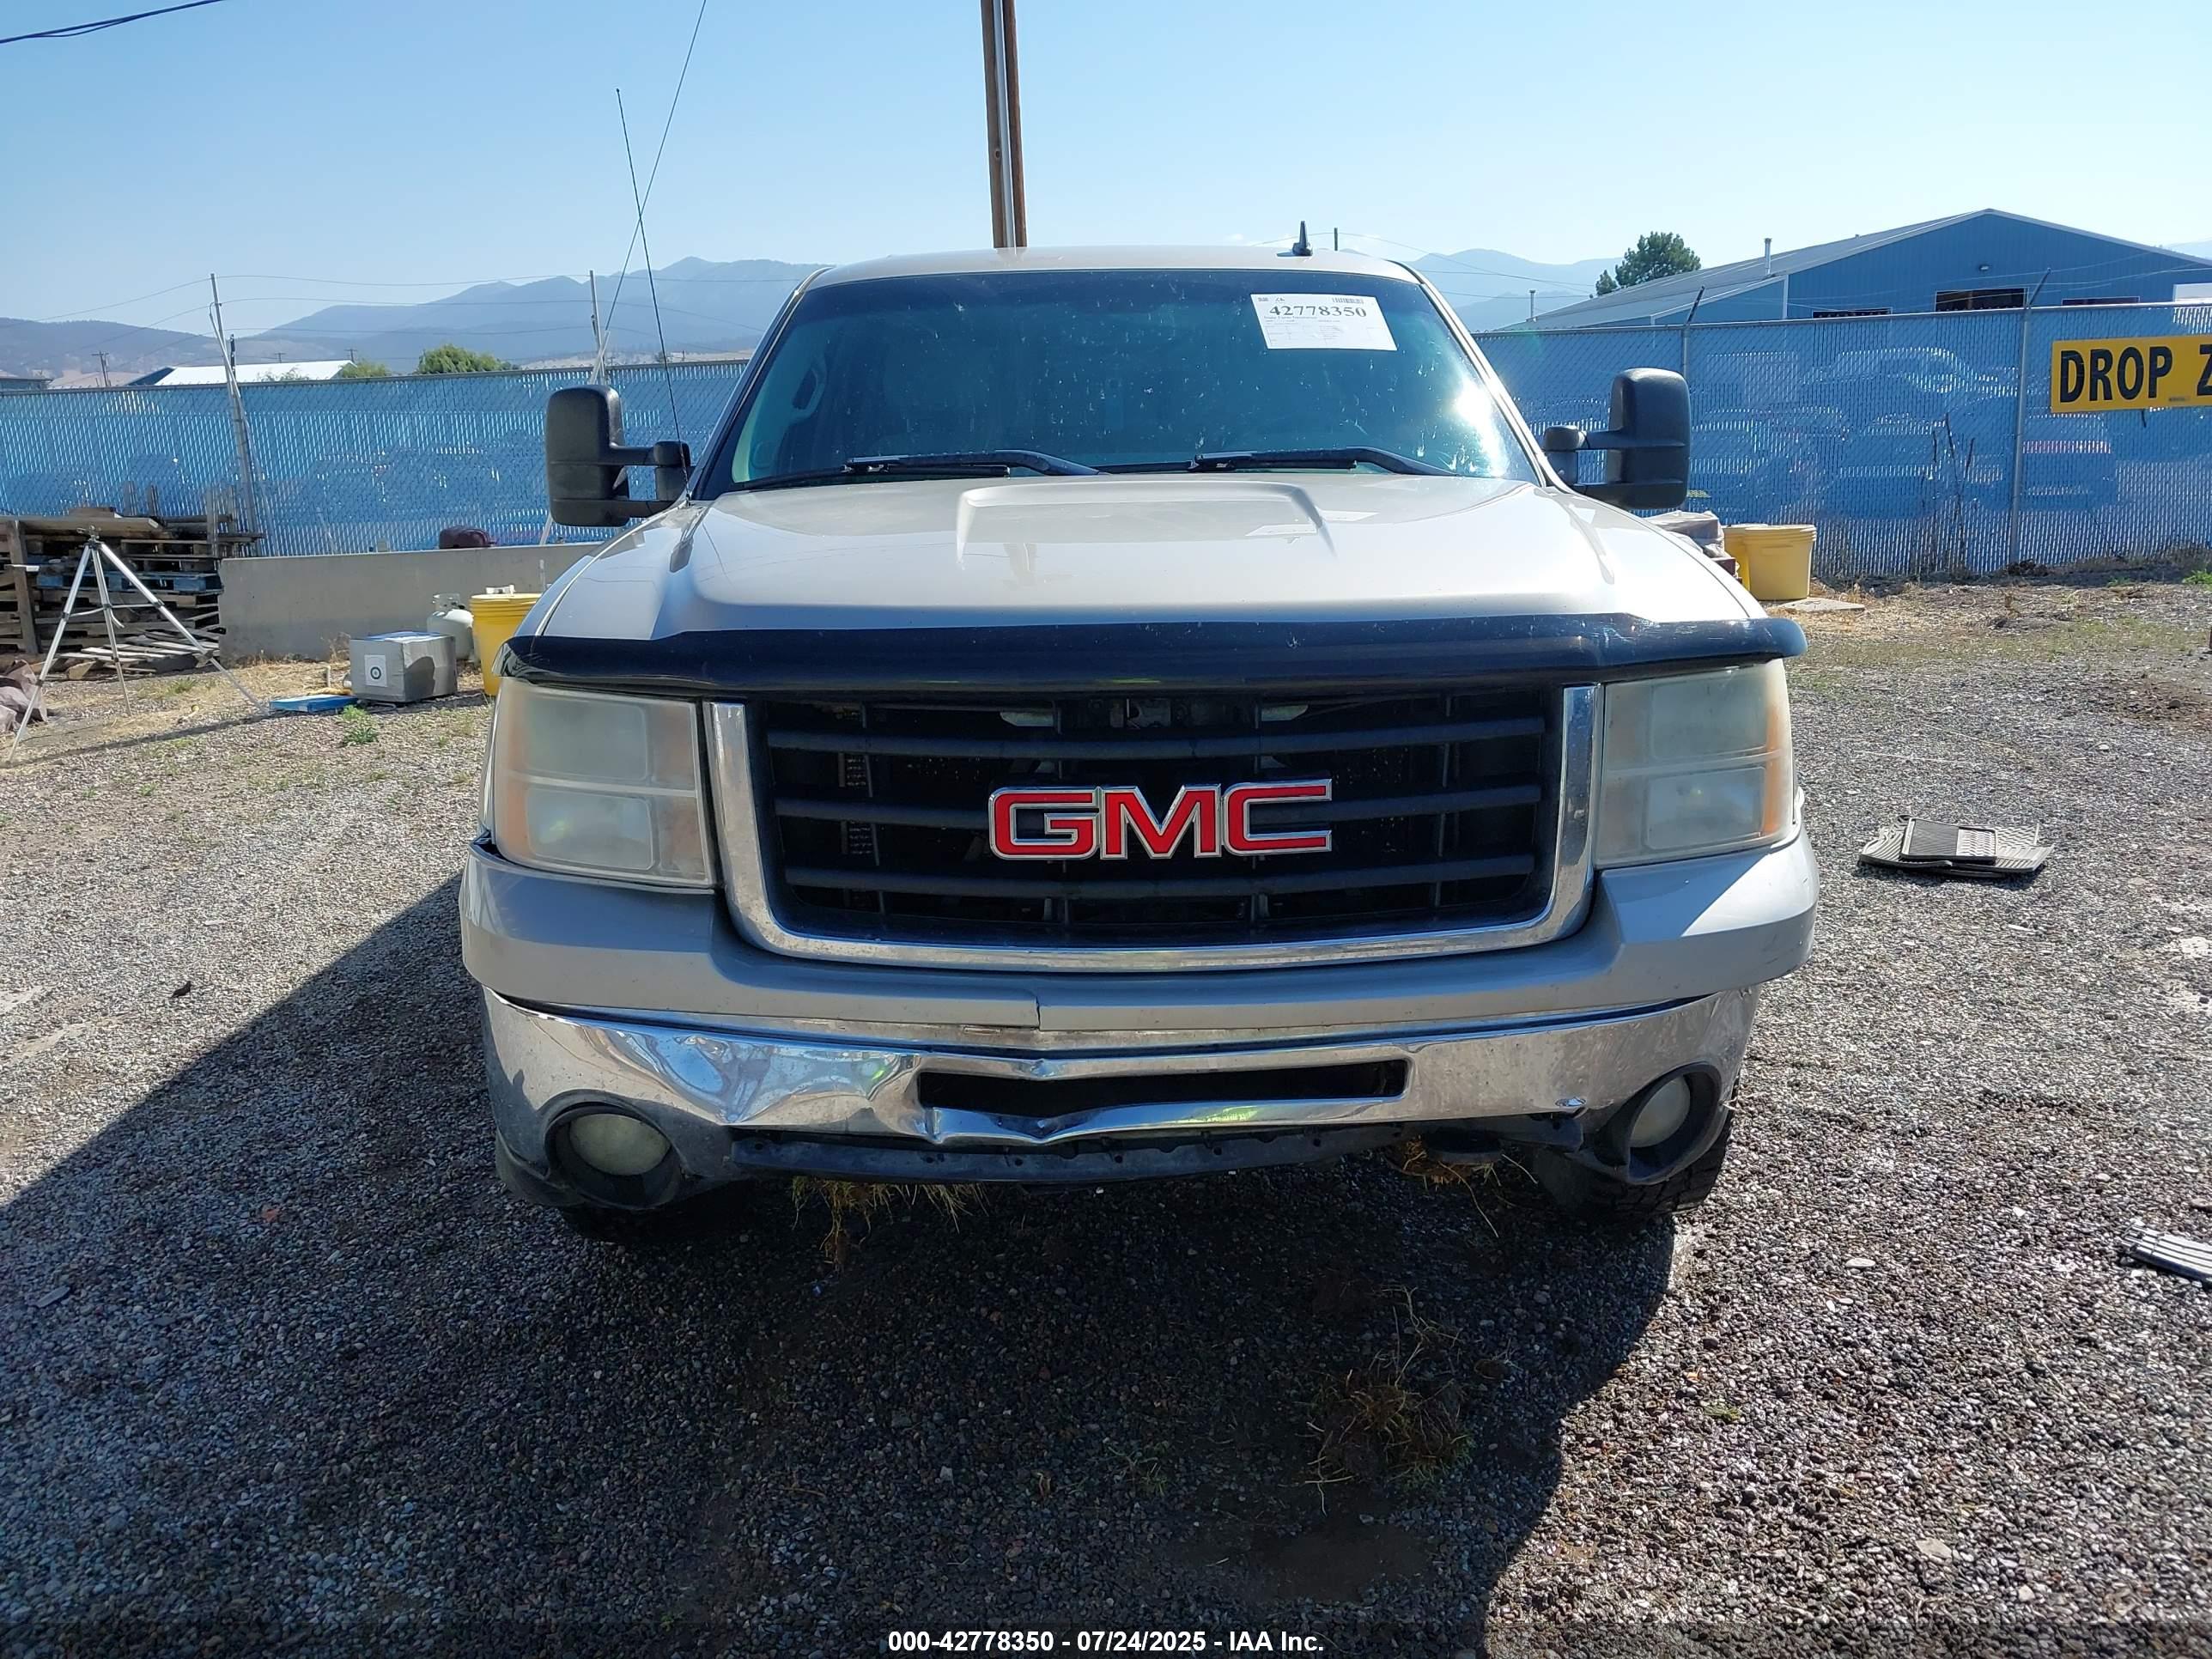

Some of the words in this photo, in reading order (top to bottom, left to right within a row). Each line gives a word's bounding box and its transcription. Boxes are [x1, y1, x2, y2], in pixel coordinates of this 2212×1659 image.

[1270, 306, 1367, 317] 42778350
[2060, 346, 2172, 403] DROP
[988, 779, 1333, 860] GMC
